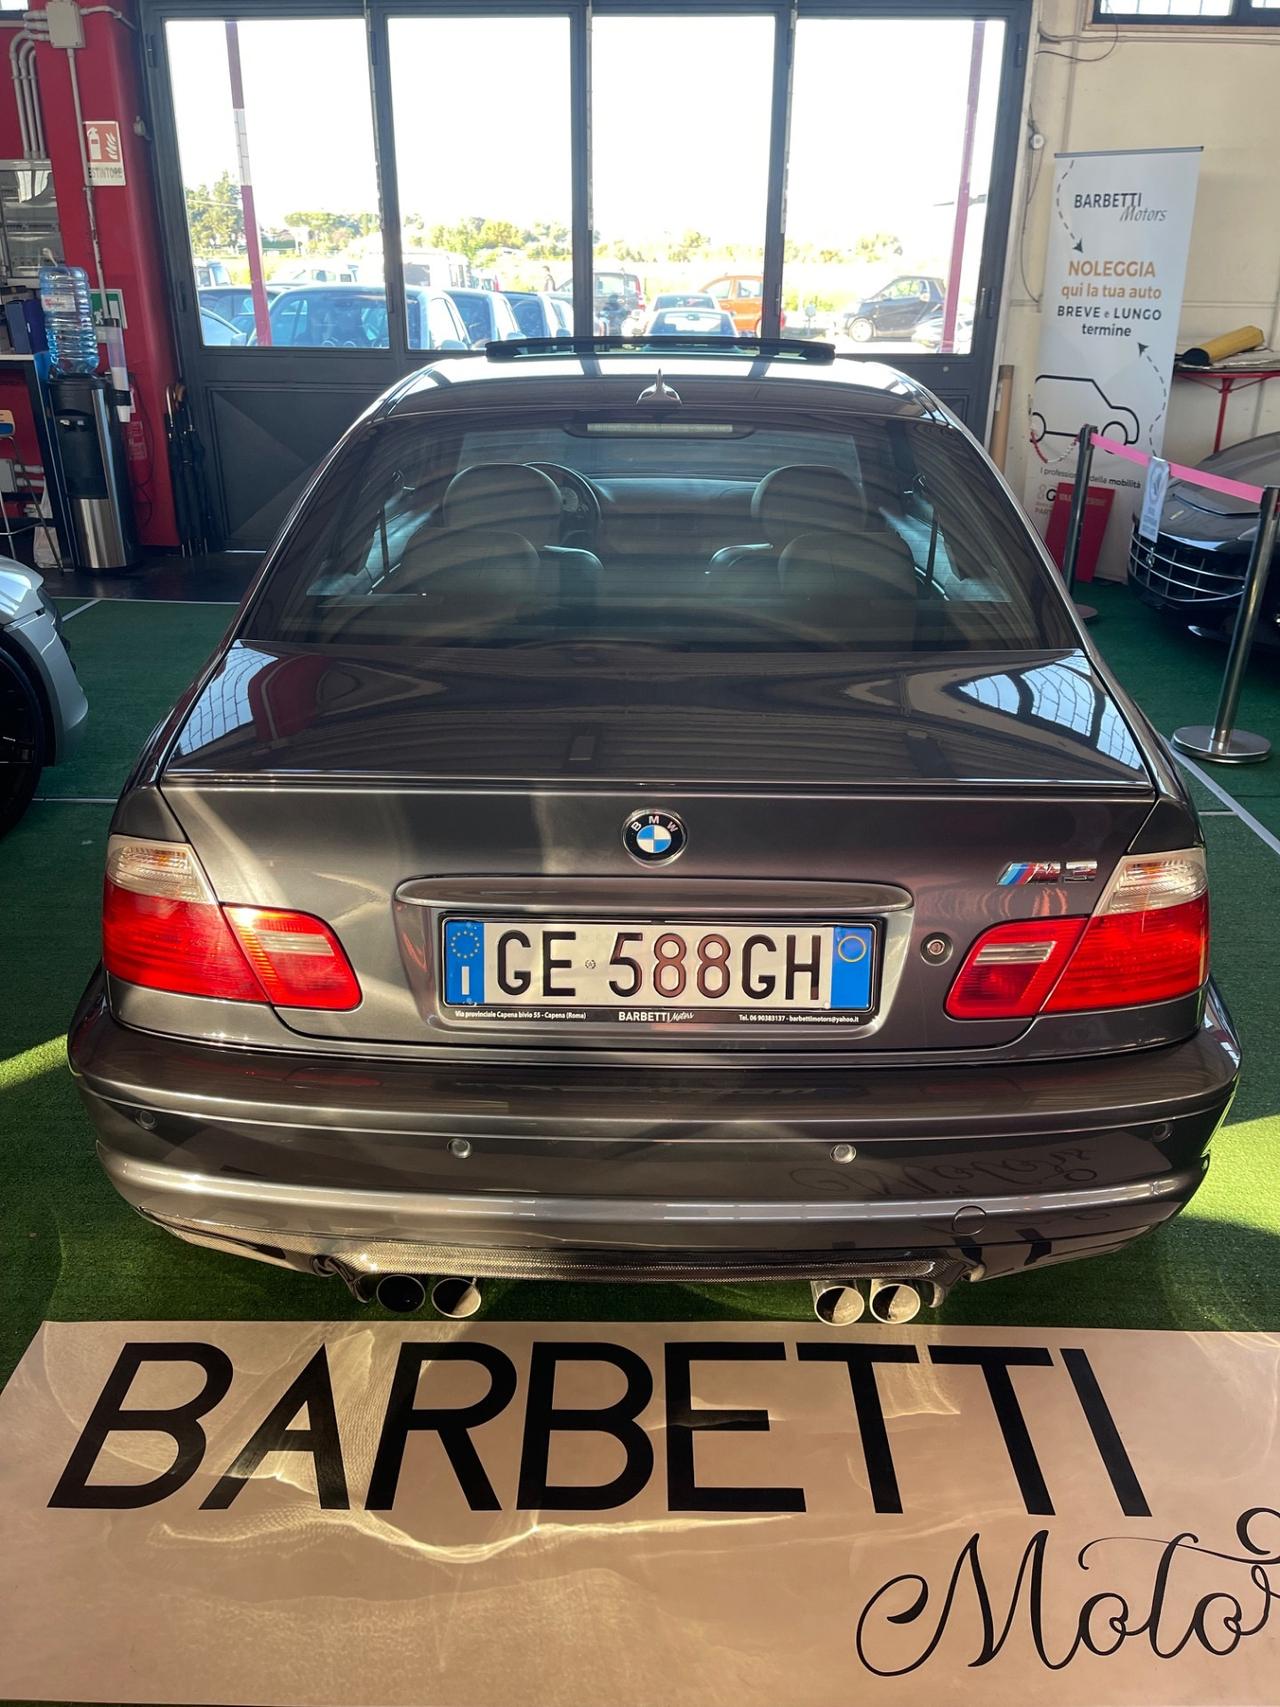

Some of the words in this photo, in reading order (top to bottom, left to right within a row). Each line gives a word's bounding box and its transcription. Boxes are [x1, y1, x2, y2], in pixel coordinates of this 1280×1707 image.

[1074, 192, 1142, 208] BARBETTI
[1119, 205, 1168, 222] Motors
[1068, 260, 1156, 278] NOLEGGIA
[1061, 282, 1084, 300] qui
[1087, 283, 1099, 298] la
[1102, 284, 1125, 298] tua
[1129, 286, 1162, 300] auto
[1057, 305, 1101, 318] BREVE
[1113, 307, 1162, 321] LUNGO
[1081, 323, 1132, 337] termine
[1109, 478, 1142, 489] mobilità
[630, 815, 679, 833] BMW
[497, 930, 577, 997] GE
[608, 932, 820, 1000] 588GH
[465, 1011, 496, 1019] provinciale
[497, 1011, 518, 1019] Capena
[544, 1012, 566, 1020] Capena
[566, 1012, 586, 1020] (Roma)
[618, 1012, 670, 1022] BARBETTI
[669, 1011, 694, 1023] Motors
[789, 1015, 859, 1023] barbettimotors@yahoo.it
[47, 1341, 1152, 1518] BARBETTI
